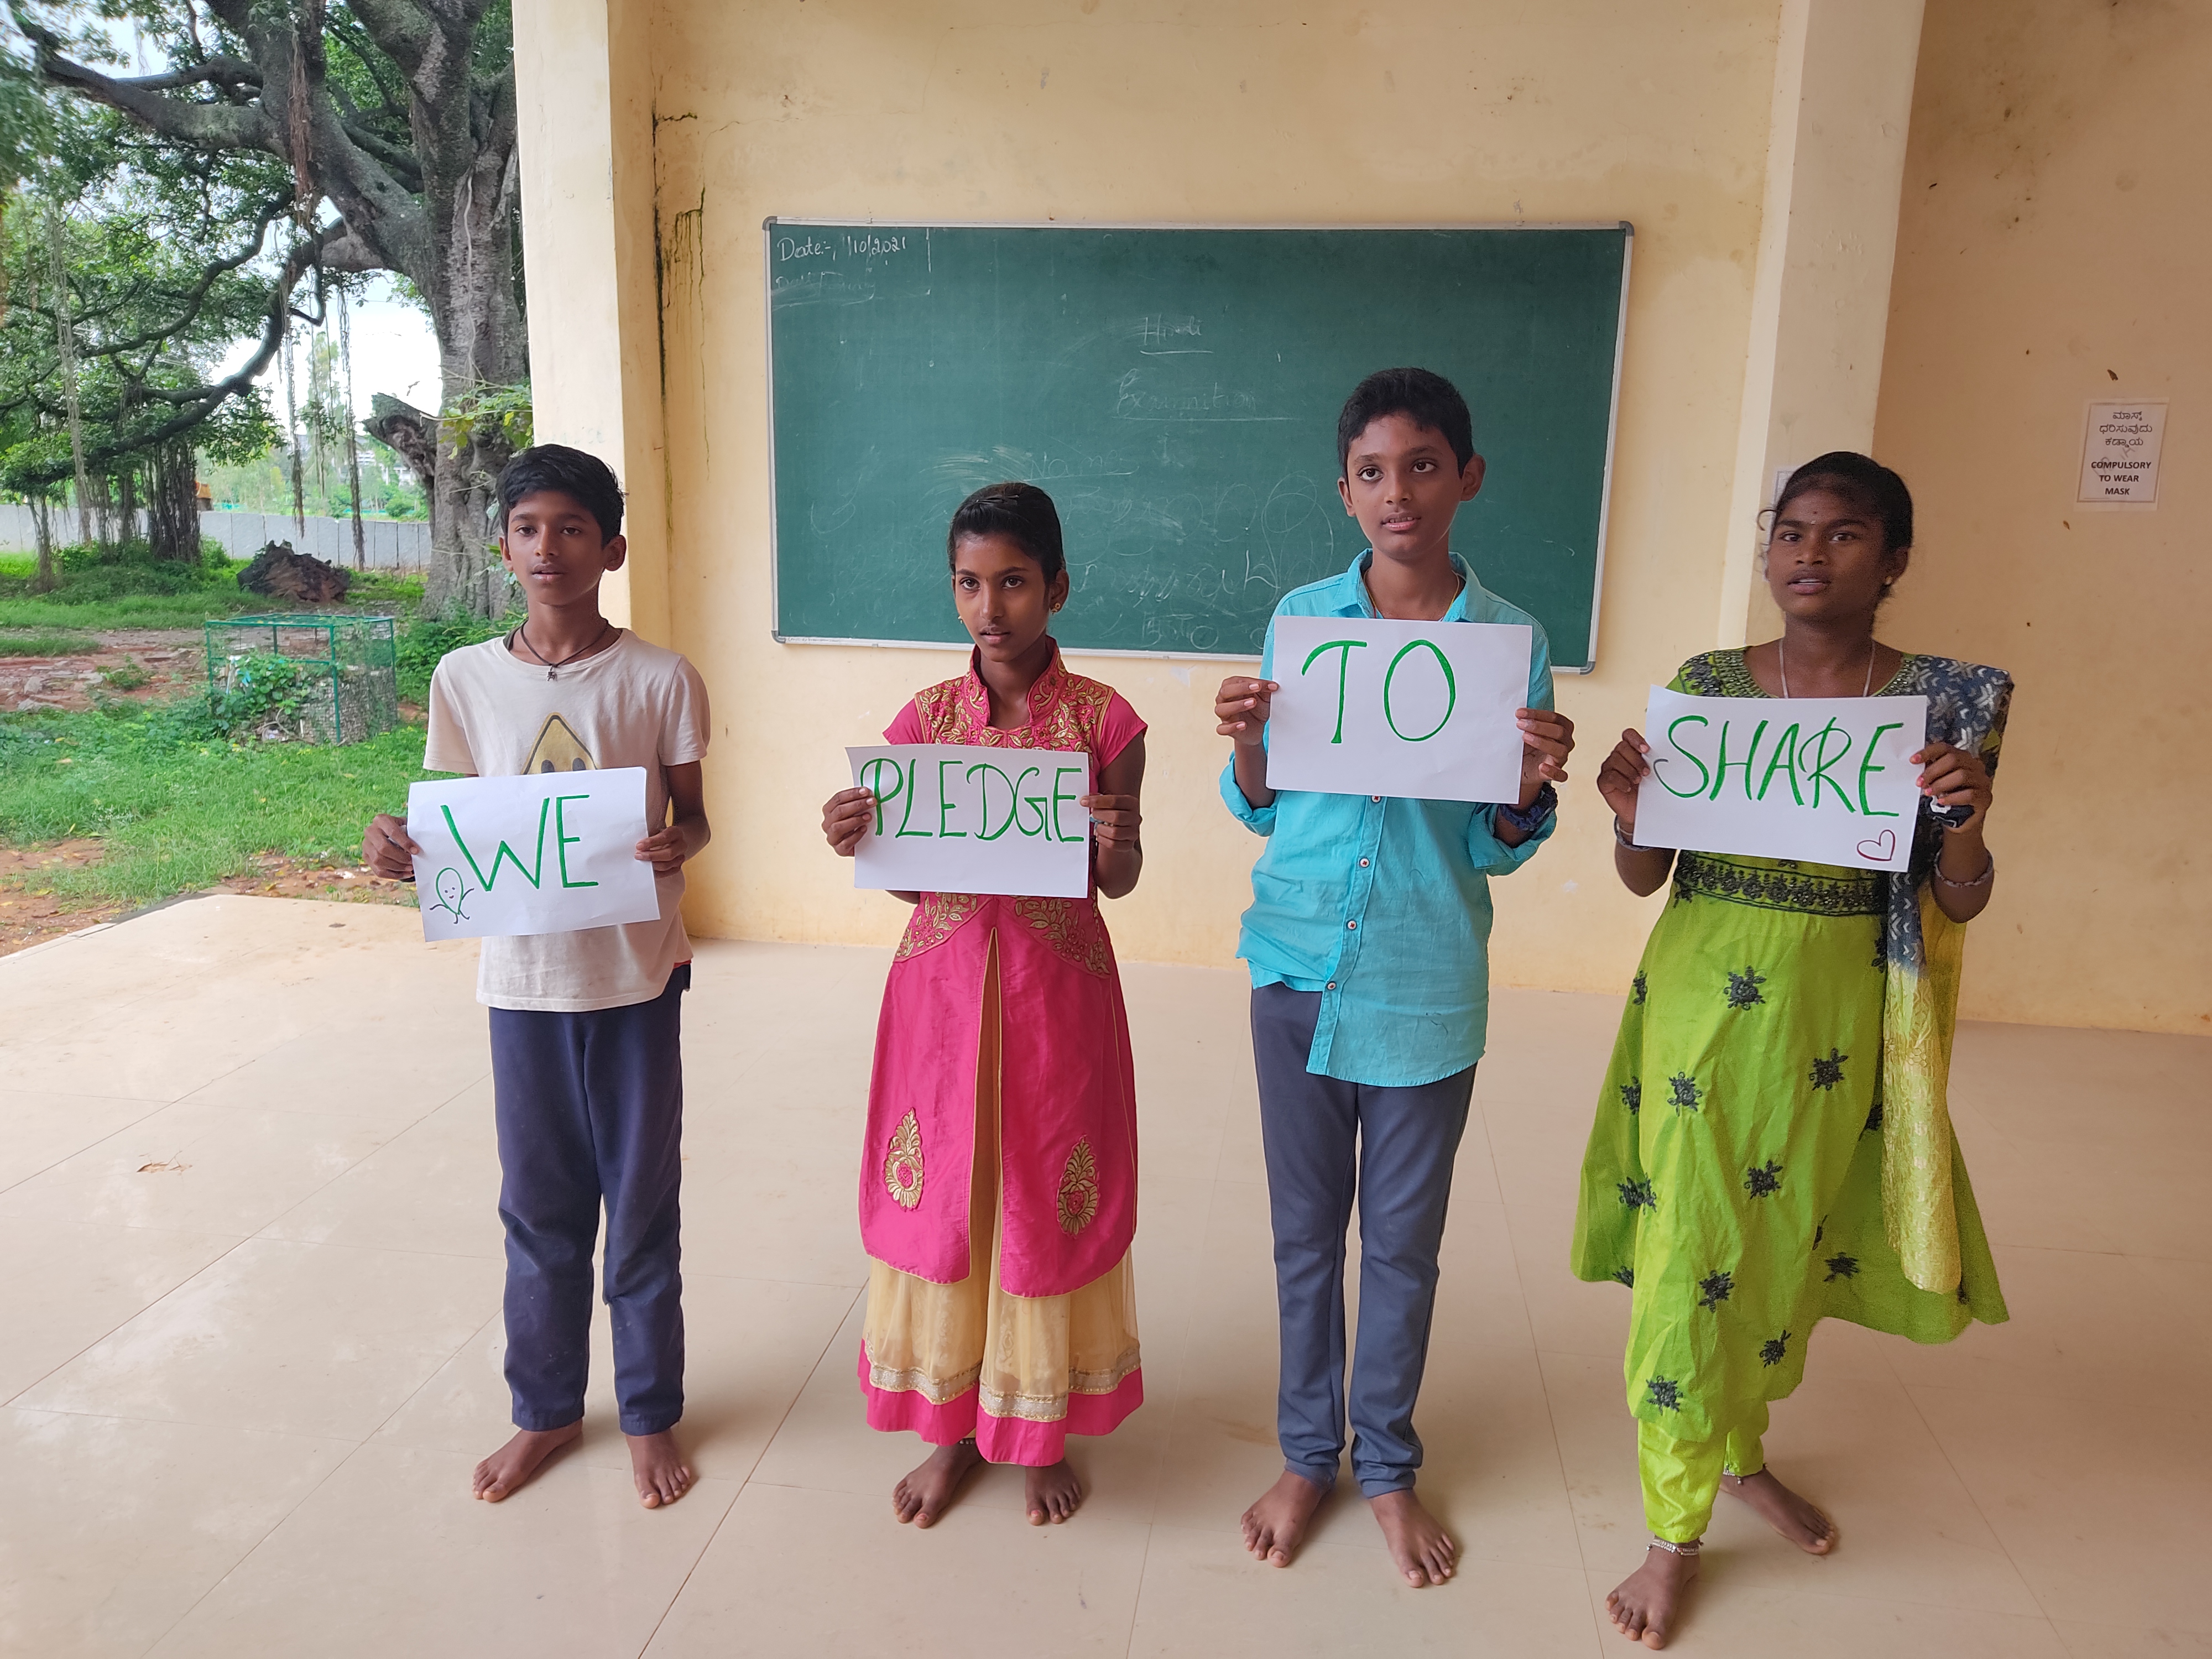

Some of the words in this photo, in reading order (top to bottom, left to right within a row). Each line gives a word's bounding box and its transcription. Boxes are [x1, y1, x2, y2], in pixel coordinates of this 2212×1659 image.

[2099, 424, 2152, 434] ಧರಿಸುವುದು
[2105, 437, 2143, 447] ಕಡ್ಡಾಯ
[1301, 639, 1456, 744] TO
[860, 758, 1085, 843] PLEDGE
[1653, 714, 1905, 817] SHARE
[440, 794, 599, 891] WE
